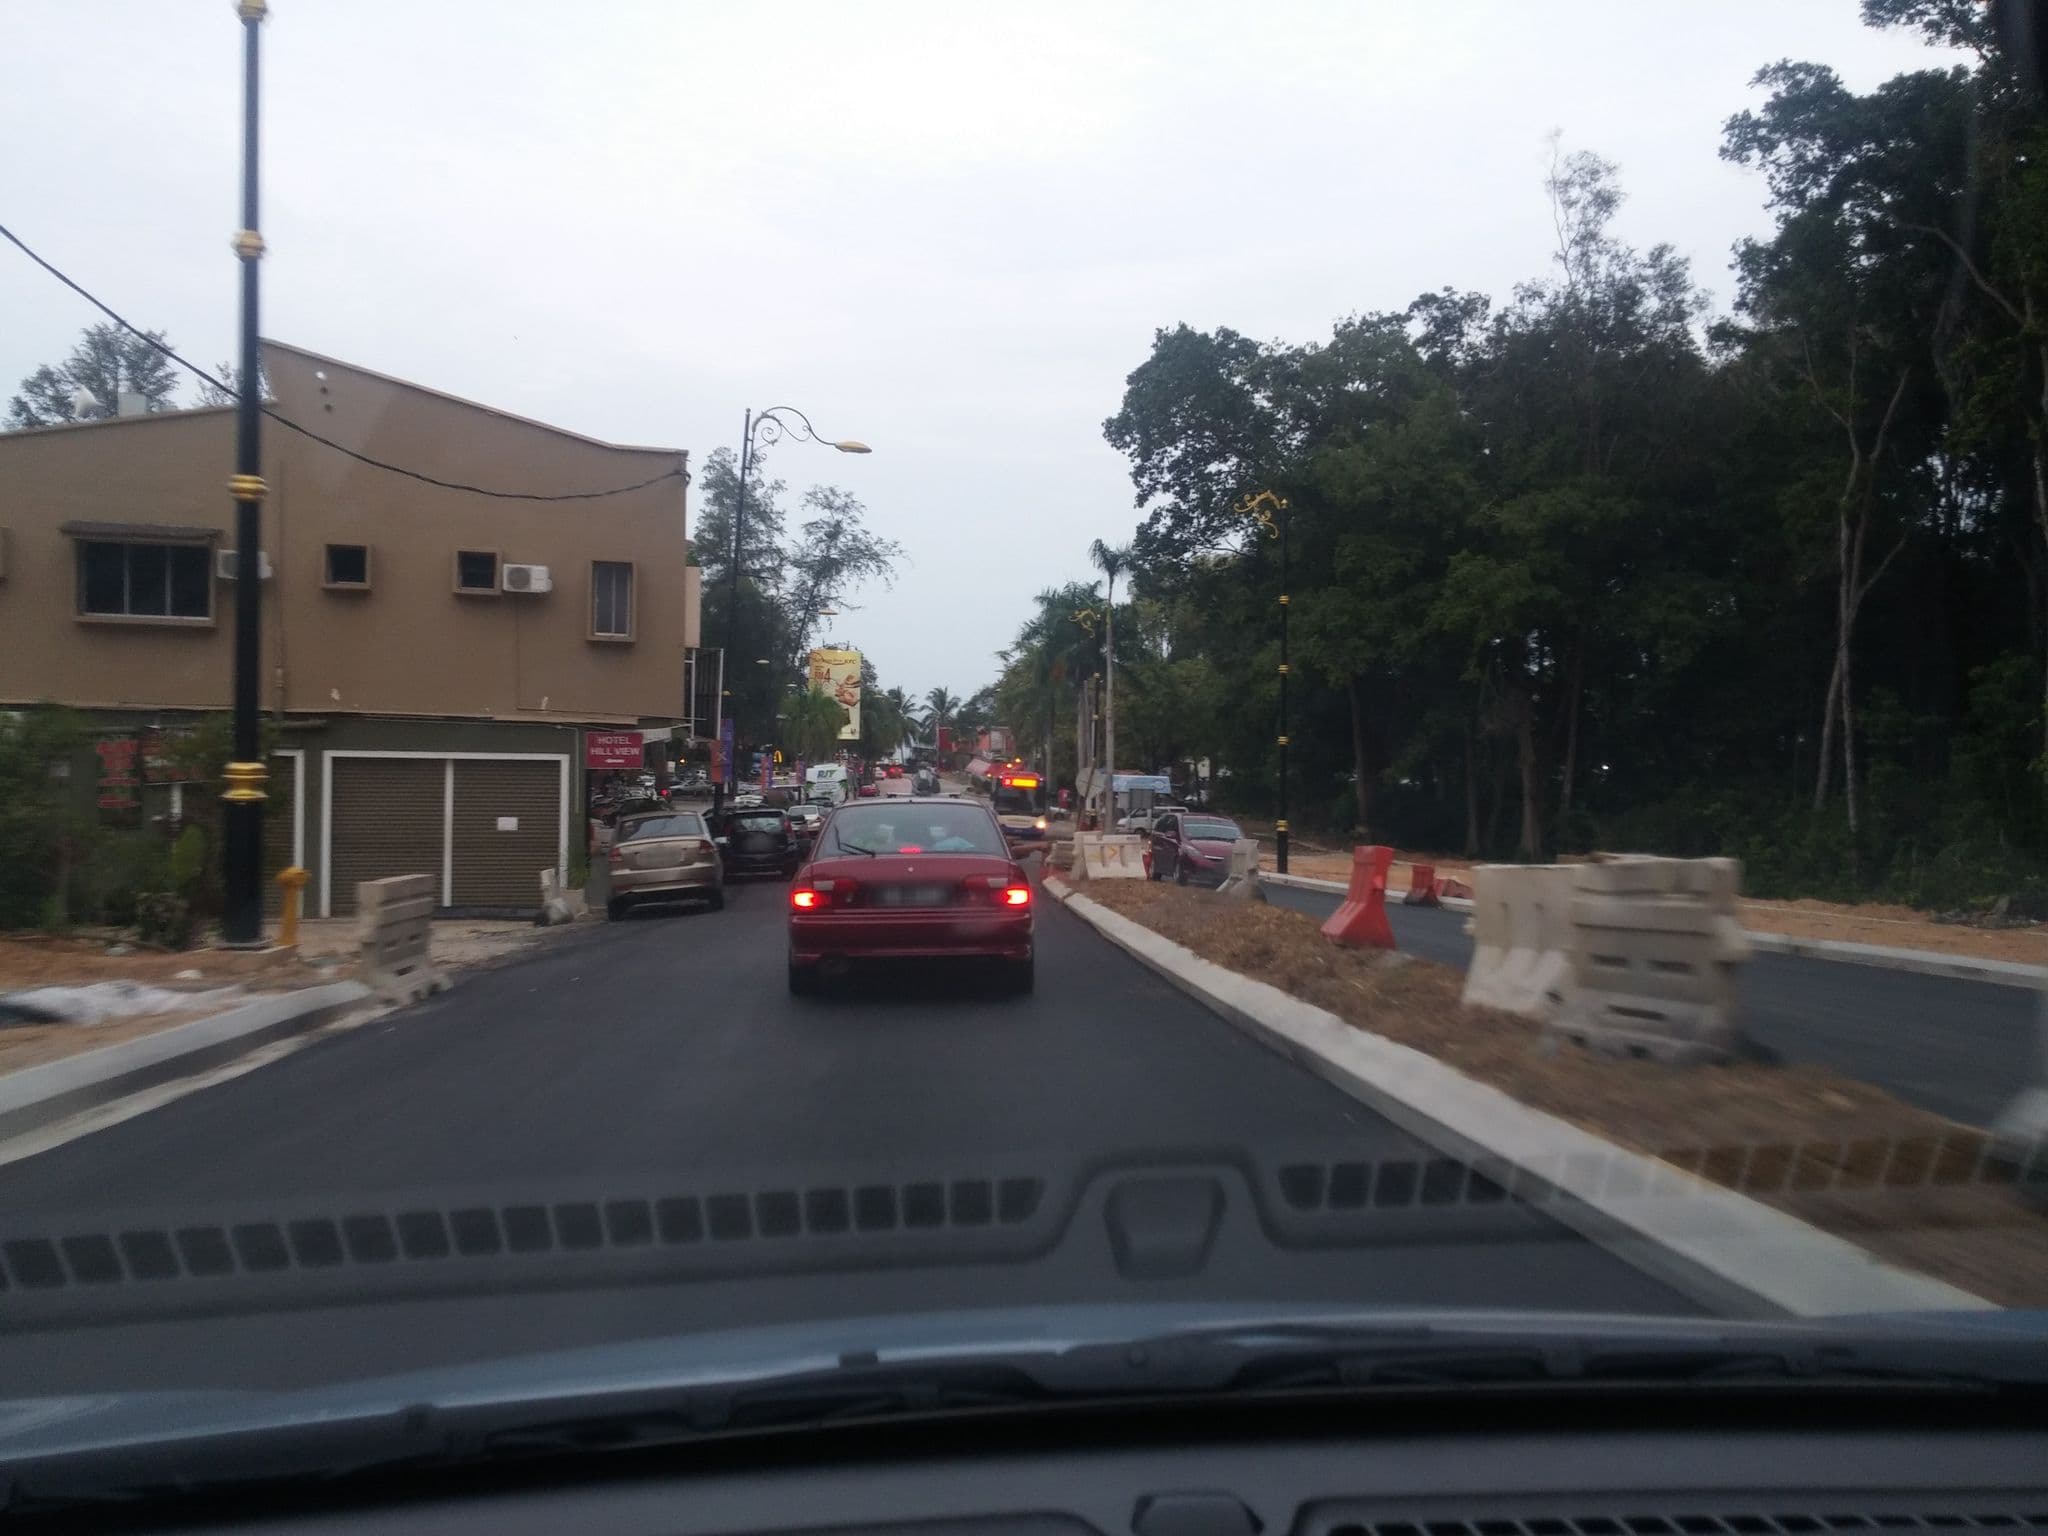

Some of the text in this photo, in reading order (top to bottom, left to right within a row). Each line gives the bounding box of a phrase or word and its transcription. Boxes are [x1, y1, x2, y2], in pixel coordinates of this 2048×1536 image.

[598, 736, 632, 745] HOTEL
[590, 747, 640, 756] HILL VIEW
